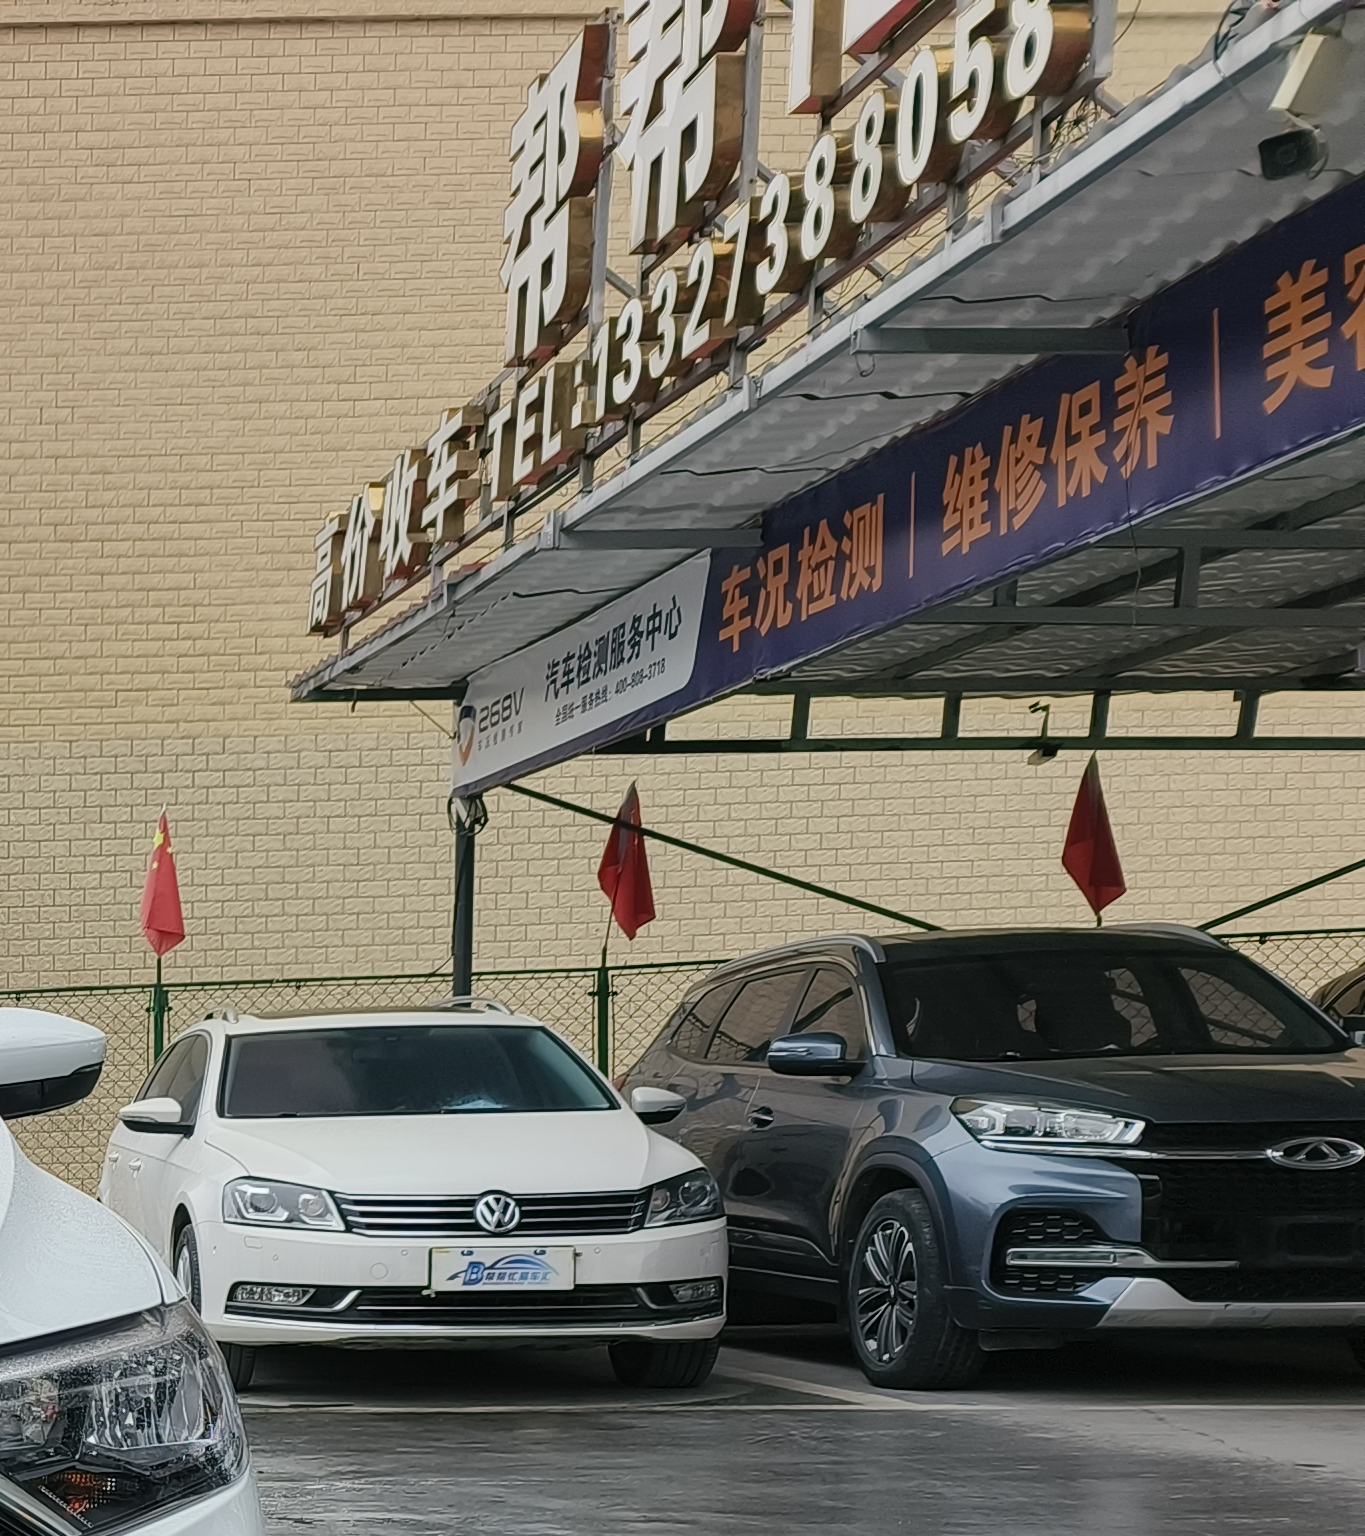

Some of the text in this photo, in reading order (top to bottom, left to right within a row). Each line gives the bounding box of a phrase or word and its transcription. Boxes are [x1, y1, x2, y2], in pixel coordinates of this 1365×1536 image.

[307, 0, 1055, 637] 高价收车 TEL:13327388058
[718, 244, 1365, 653] 车况检测 维修保养 美
[478, 687, 525, 733] 268V
[544, 594, 683, 703] 汽车检测服务中心
